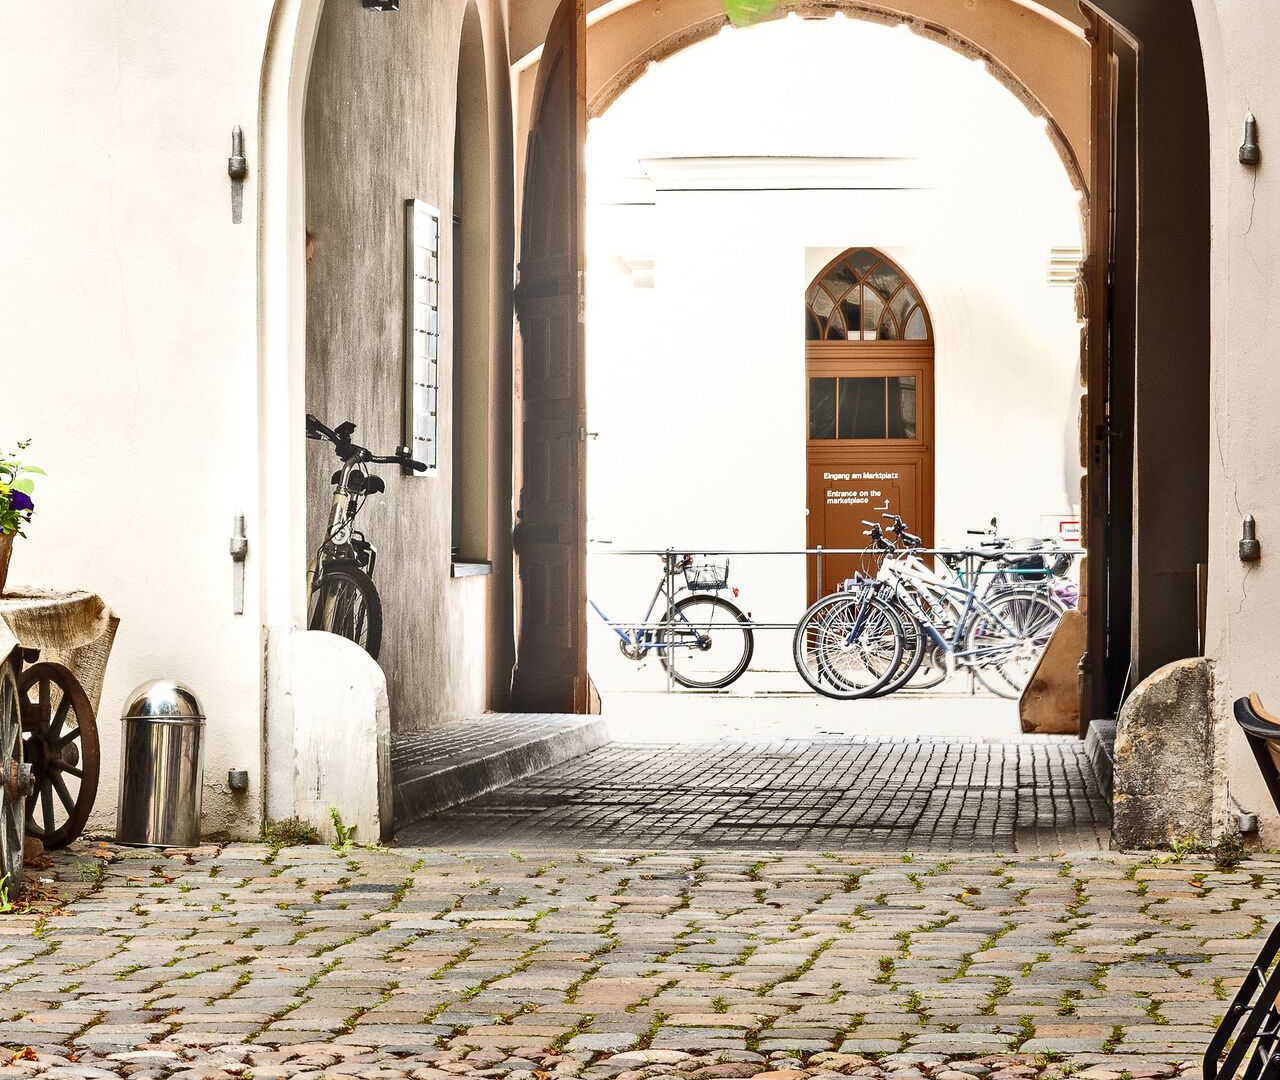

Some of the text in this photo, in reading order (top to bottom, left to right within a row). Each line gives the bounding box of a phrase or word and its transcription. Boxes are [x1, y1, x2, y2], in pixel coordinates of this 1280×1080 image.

[823, 472, 850, 480] Eingang
[863, 472, 899, 480] Marktplatz
[826, 497, 869, 505] marketplace
